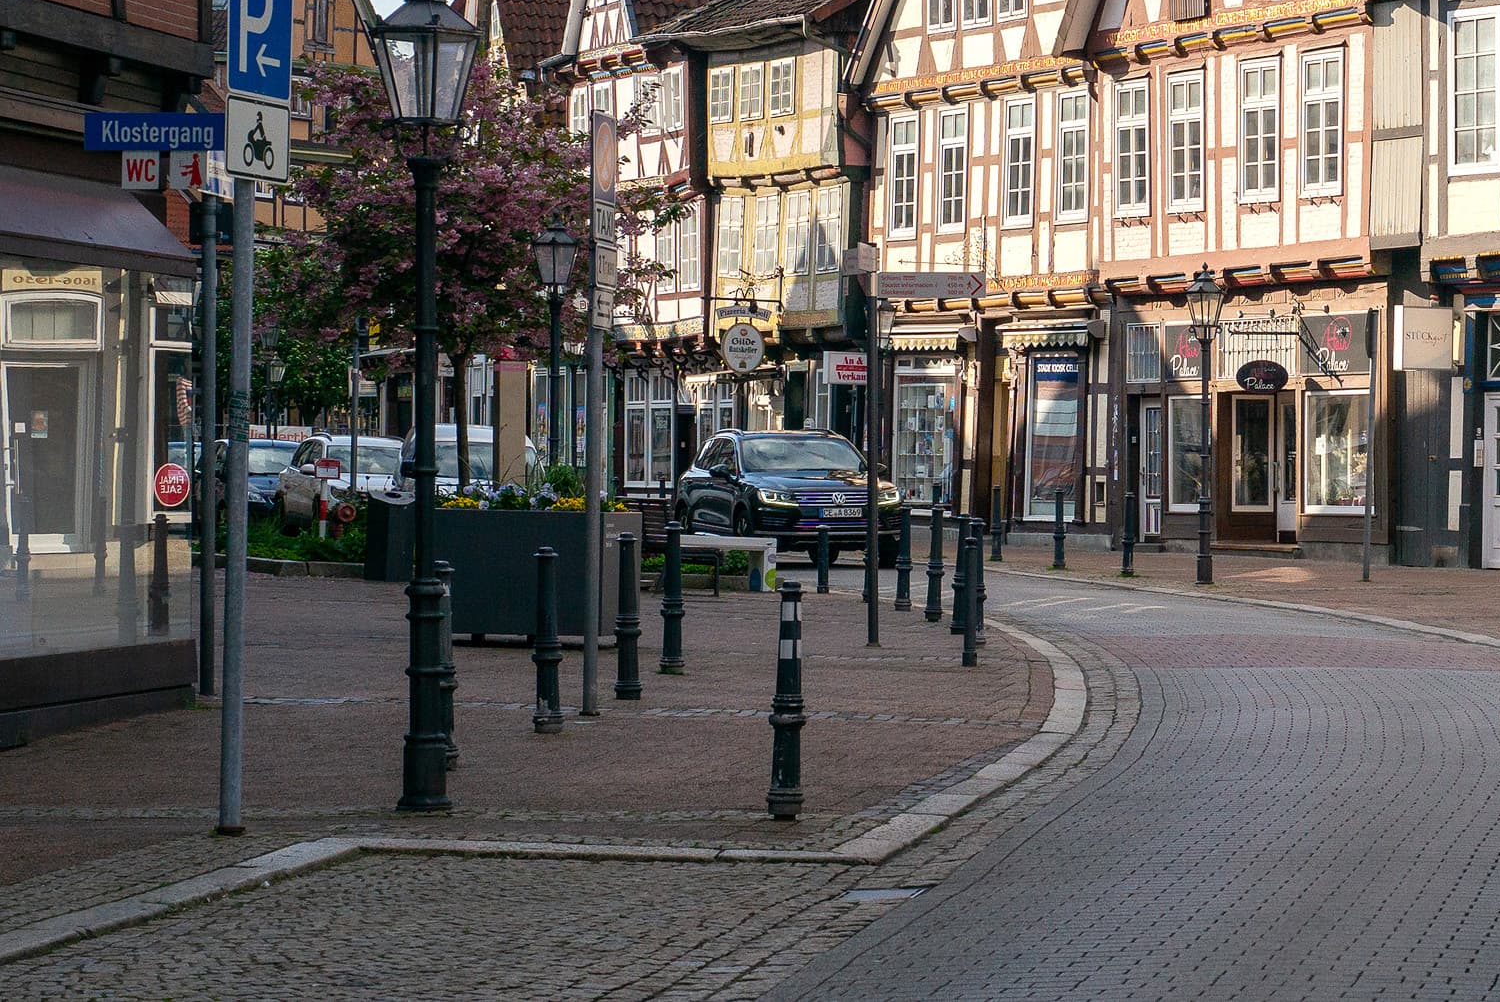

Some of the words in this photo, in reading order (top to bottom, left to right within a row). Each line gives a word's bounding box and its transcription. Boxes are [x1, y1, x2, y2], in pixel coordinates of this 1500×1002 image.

[101, 120, 215, 148] Klostergang
[126, 158, 156, 183] WC
[596, 208, 614, 238] TAXI
[719, 307, 747, 318] Pizzeria
[731, 337, 756, 346] Gilde
[843, 356, 854, 365] An
[856, 356, 864, 365] &
[1169, 354, 1200, 377] Palace
[1315, 347, 1350, 372] Palace
[837, 371, 867, 381] Verkau
[1243, 376, 1275, 391] Palace
